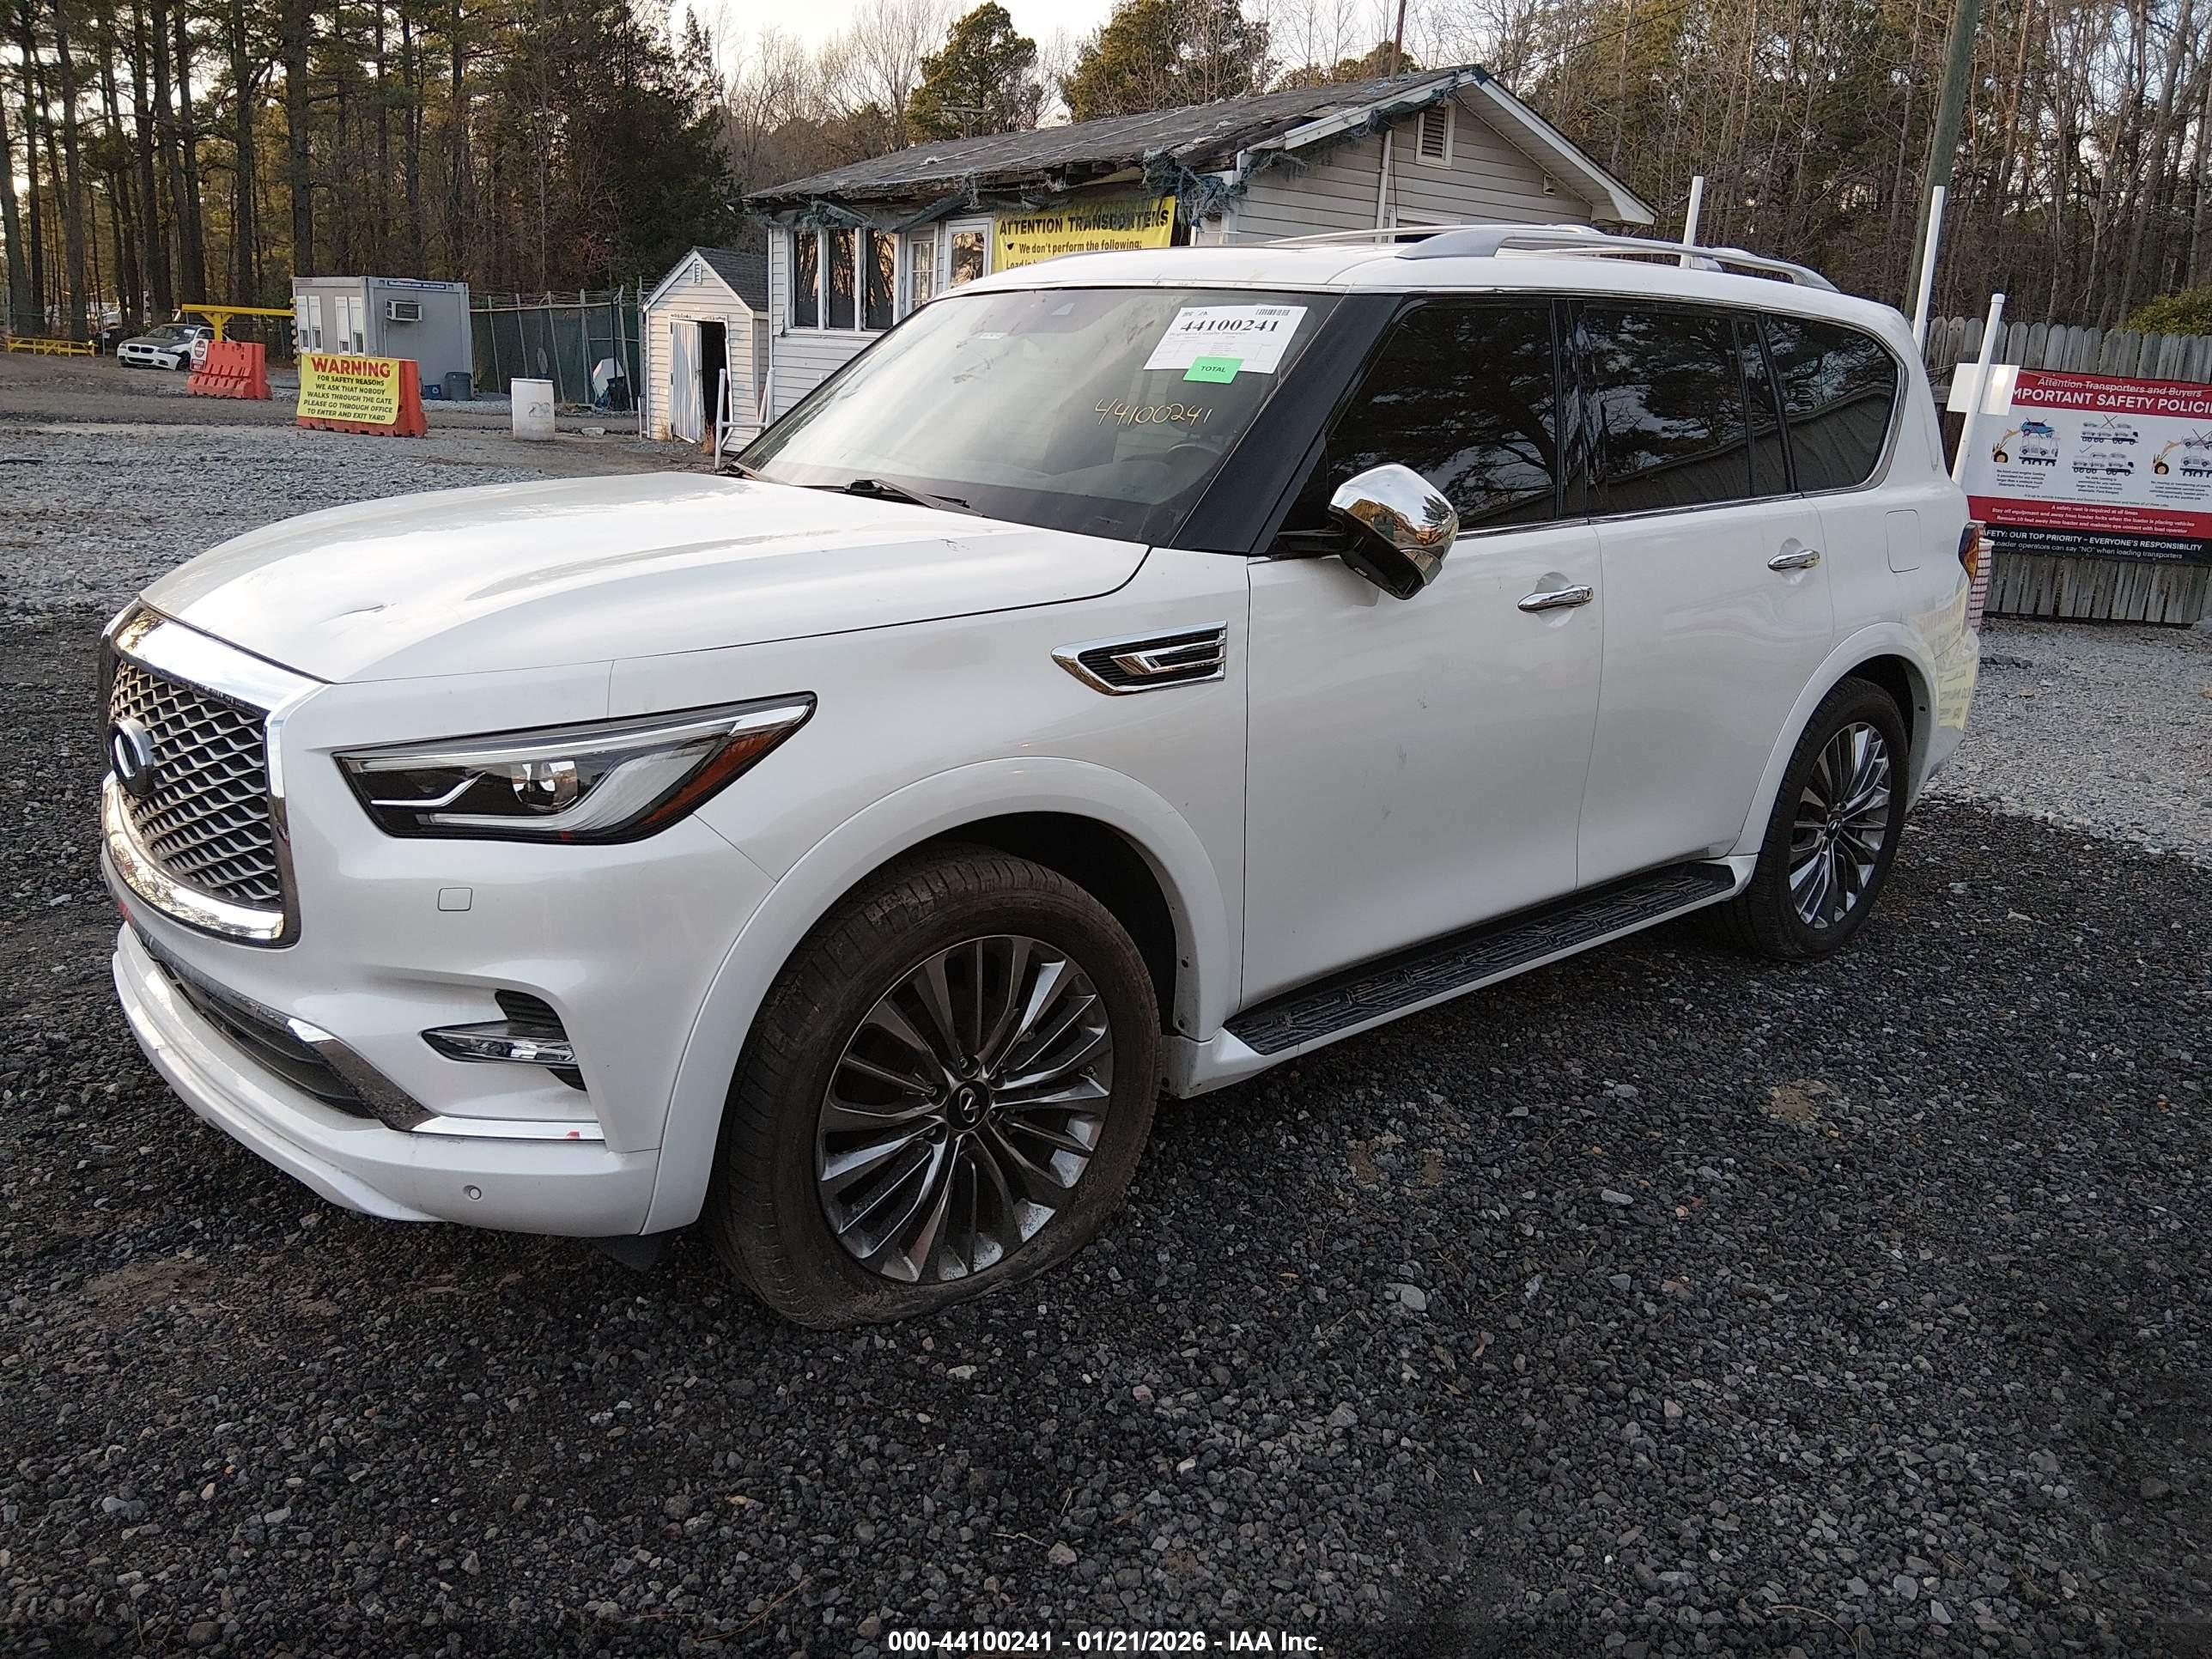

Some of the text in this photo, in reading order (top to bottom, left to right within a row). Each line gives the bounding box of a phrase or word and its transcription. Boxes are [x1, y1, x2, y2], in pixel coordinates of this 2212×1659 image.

[1000, 218, 1063, 235] ATTENTION
[1019, 238, 1142, 255] We don't perform the following:
[1181, 319, 1279, 332] 44100241
[311, 357, 391, 378] WARNING
[2038, 377, 2203, 398] Attention Transporters and Buyers
[2014, 388, 2094, 404] MPORTANT
[2096, 393, 2154, 409] SAFETY
[1095, 398, 1212, 427] 44100241
[1984, 529, 2008, 538] AFETY:
[2046, 534, 2083, 543] PRIORITY
[2089, 537, 2139, 546] EVERYONE'S
[2140, 540, 2203, 551] RESPONSIBILITY
[2117, 549, 2142, 557] loading
[2142, 550, 2183, 559] transporters
